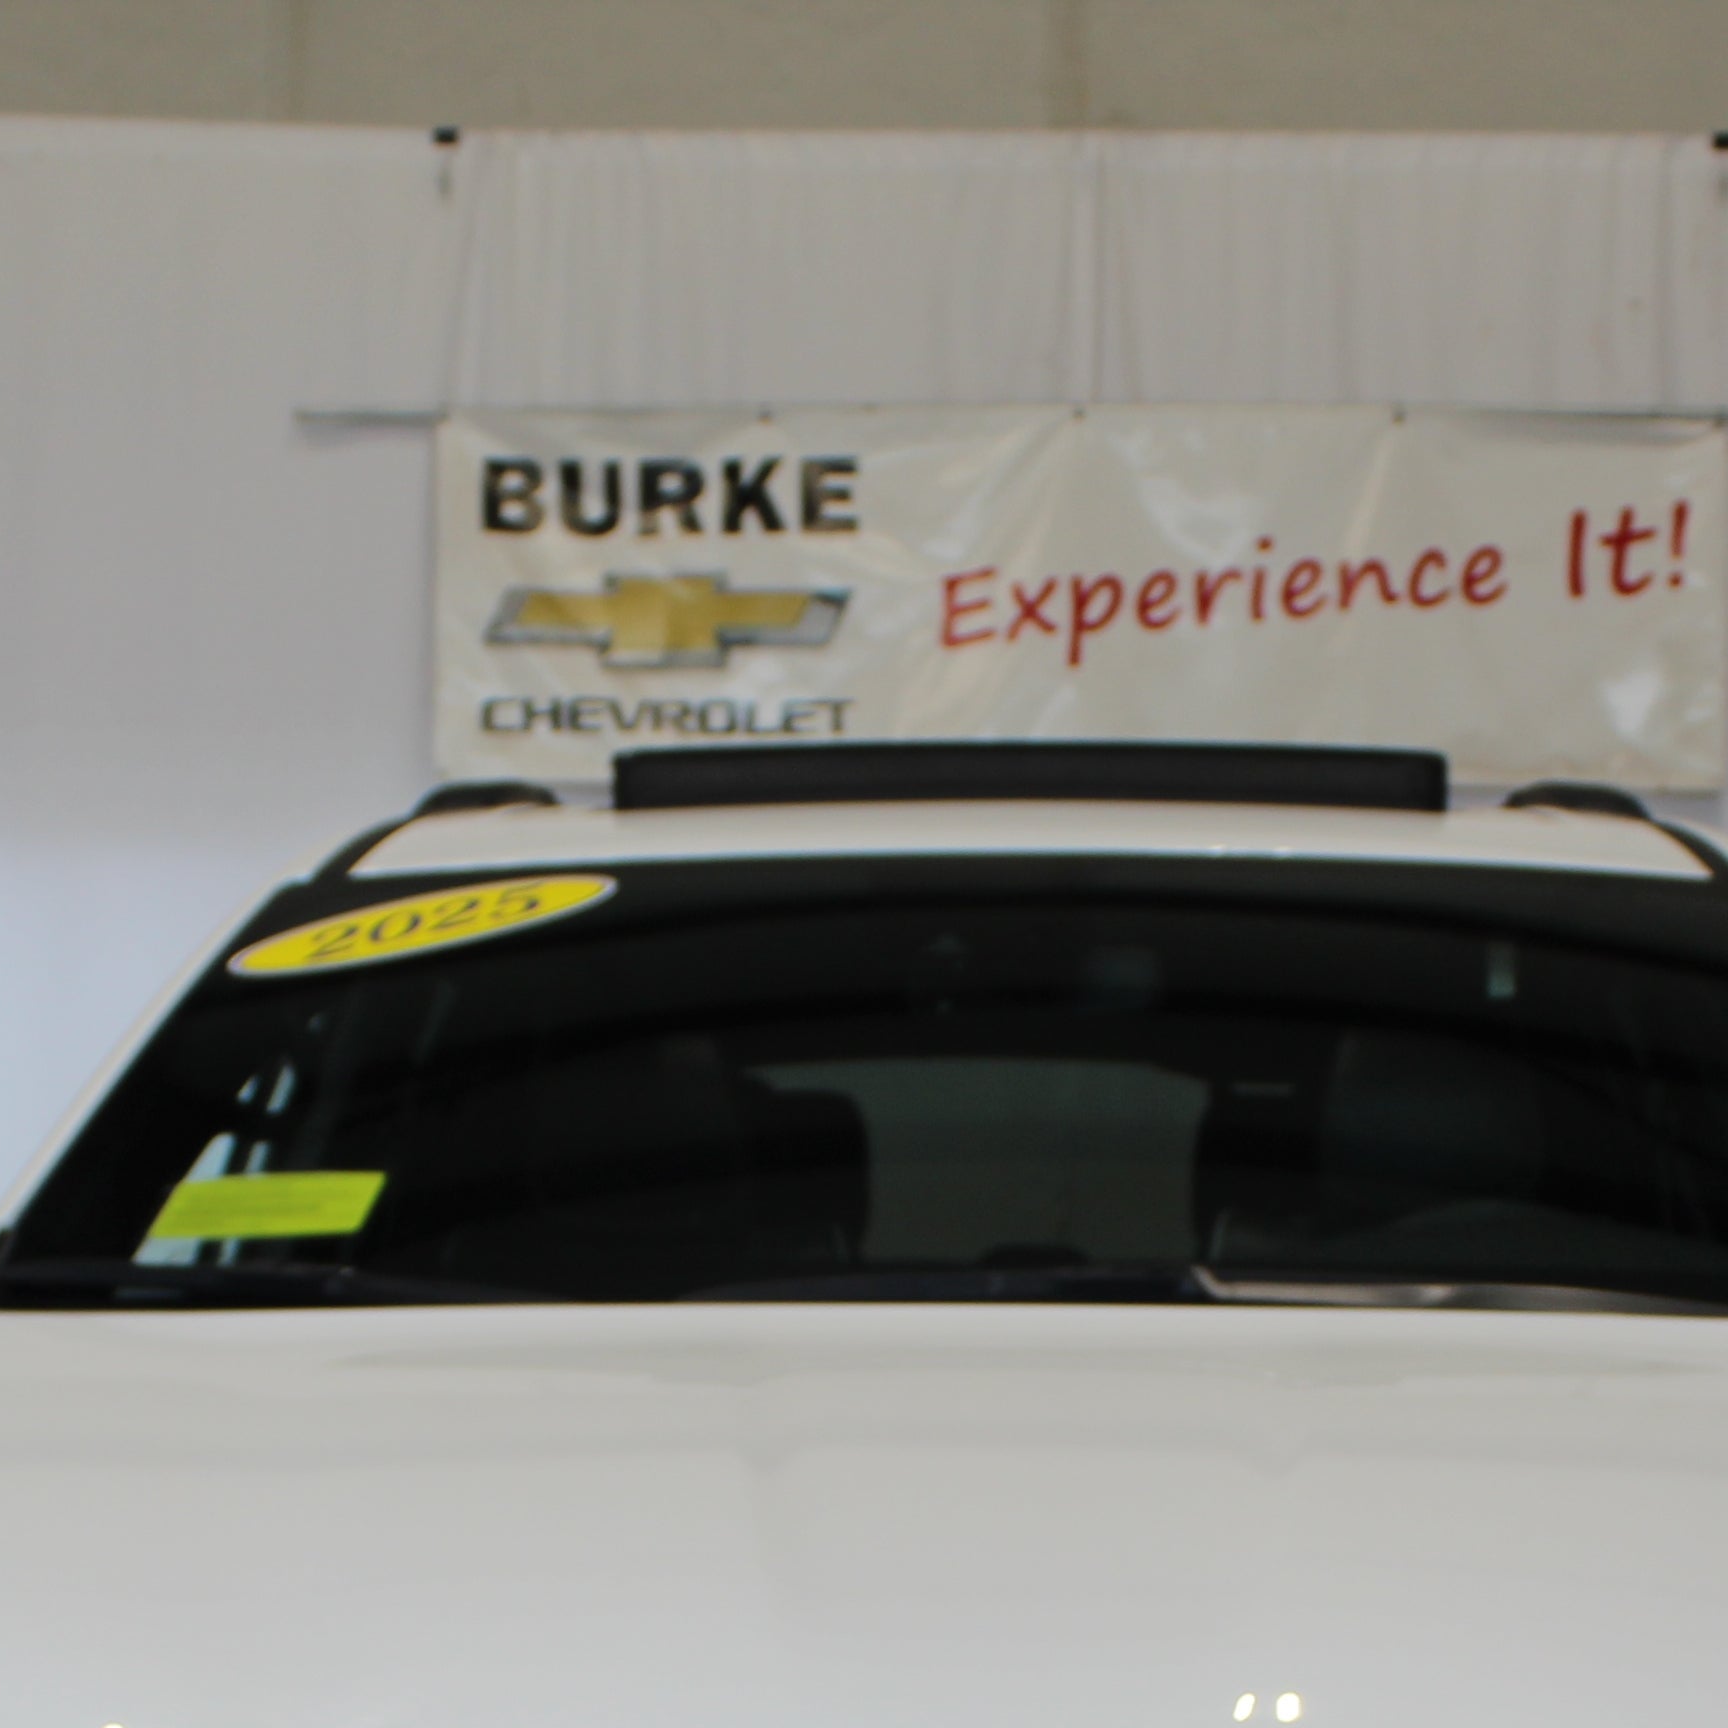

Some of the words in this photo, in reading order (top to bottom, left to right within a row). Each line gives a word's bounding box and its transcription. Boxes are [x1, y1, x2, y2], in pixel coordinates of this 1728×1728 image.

[481, 455, 860, 536] BURKE
[938, 537, 1508, 668] Experience
[1565, 501, 1690, 598] It!
[480, 695, 854, 734] CHEVROLET
[305, 881, 543, 960] 2025
